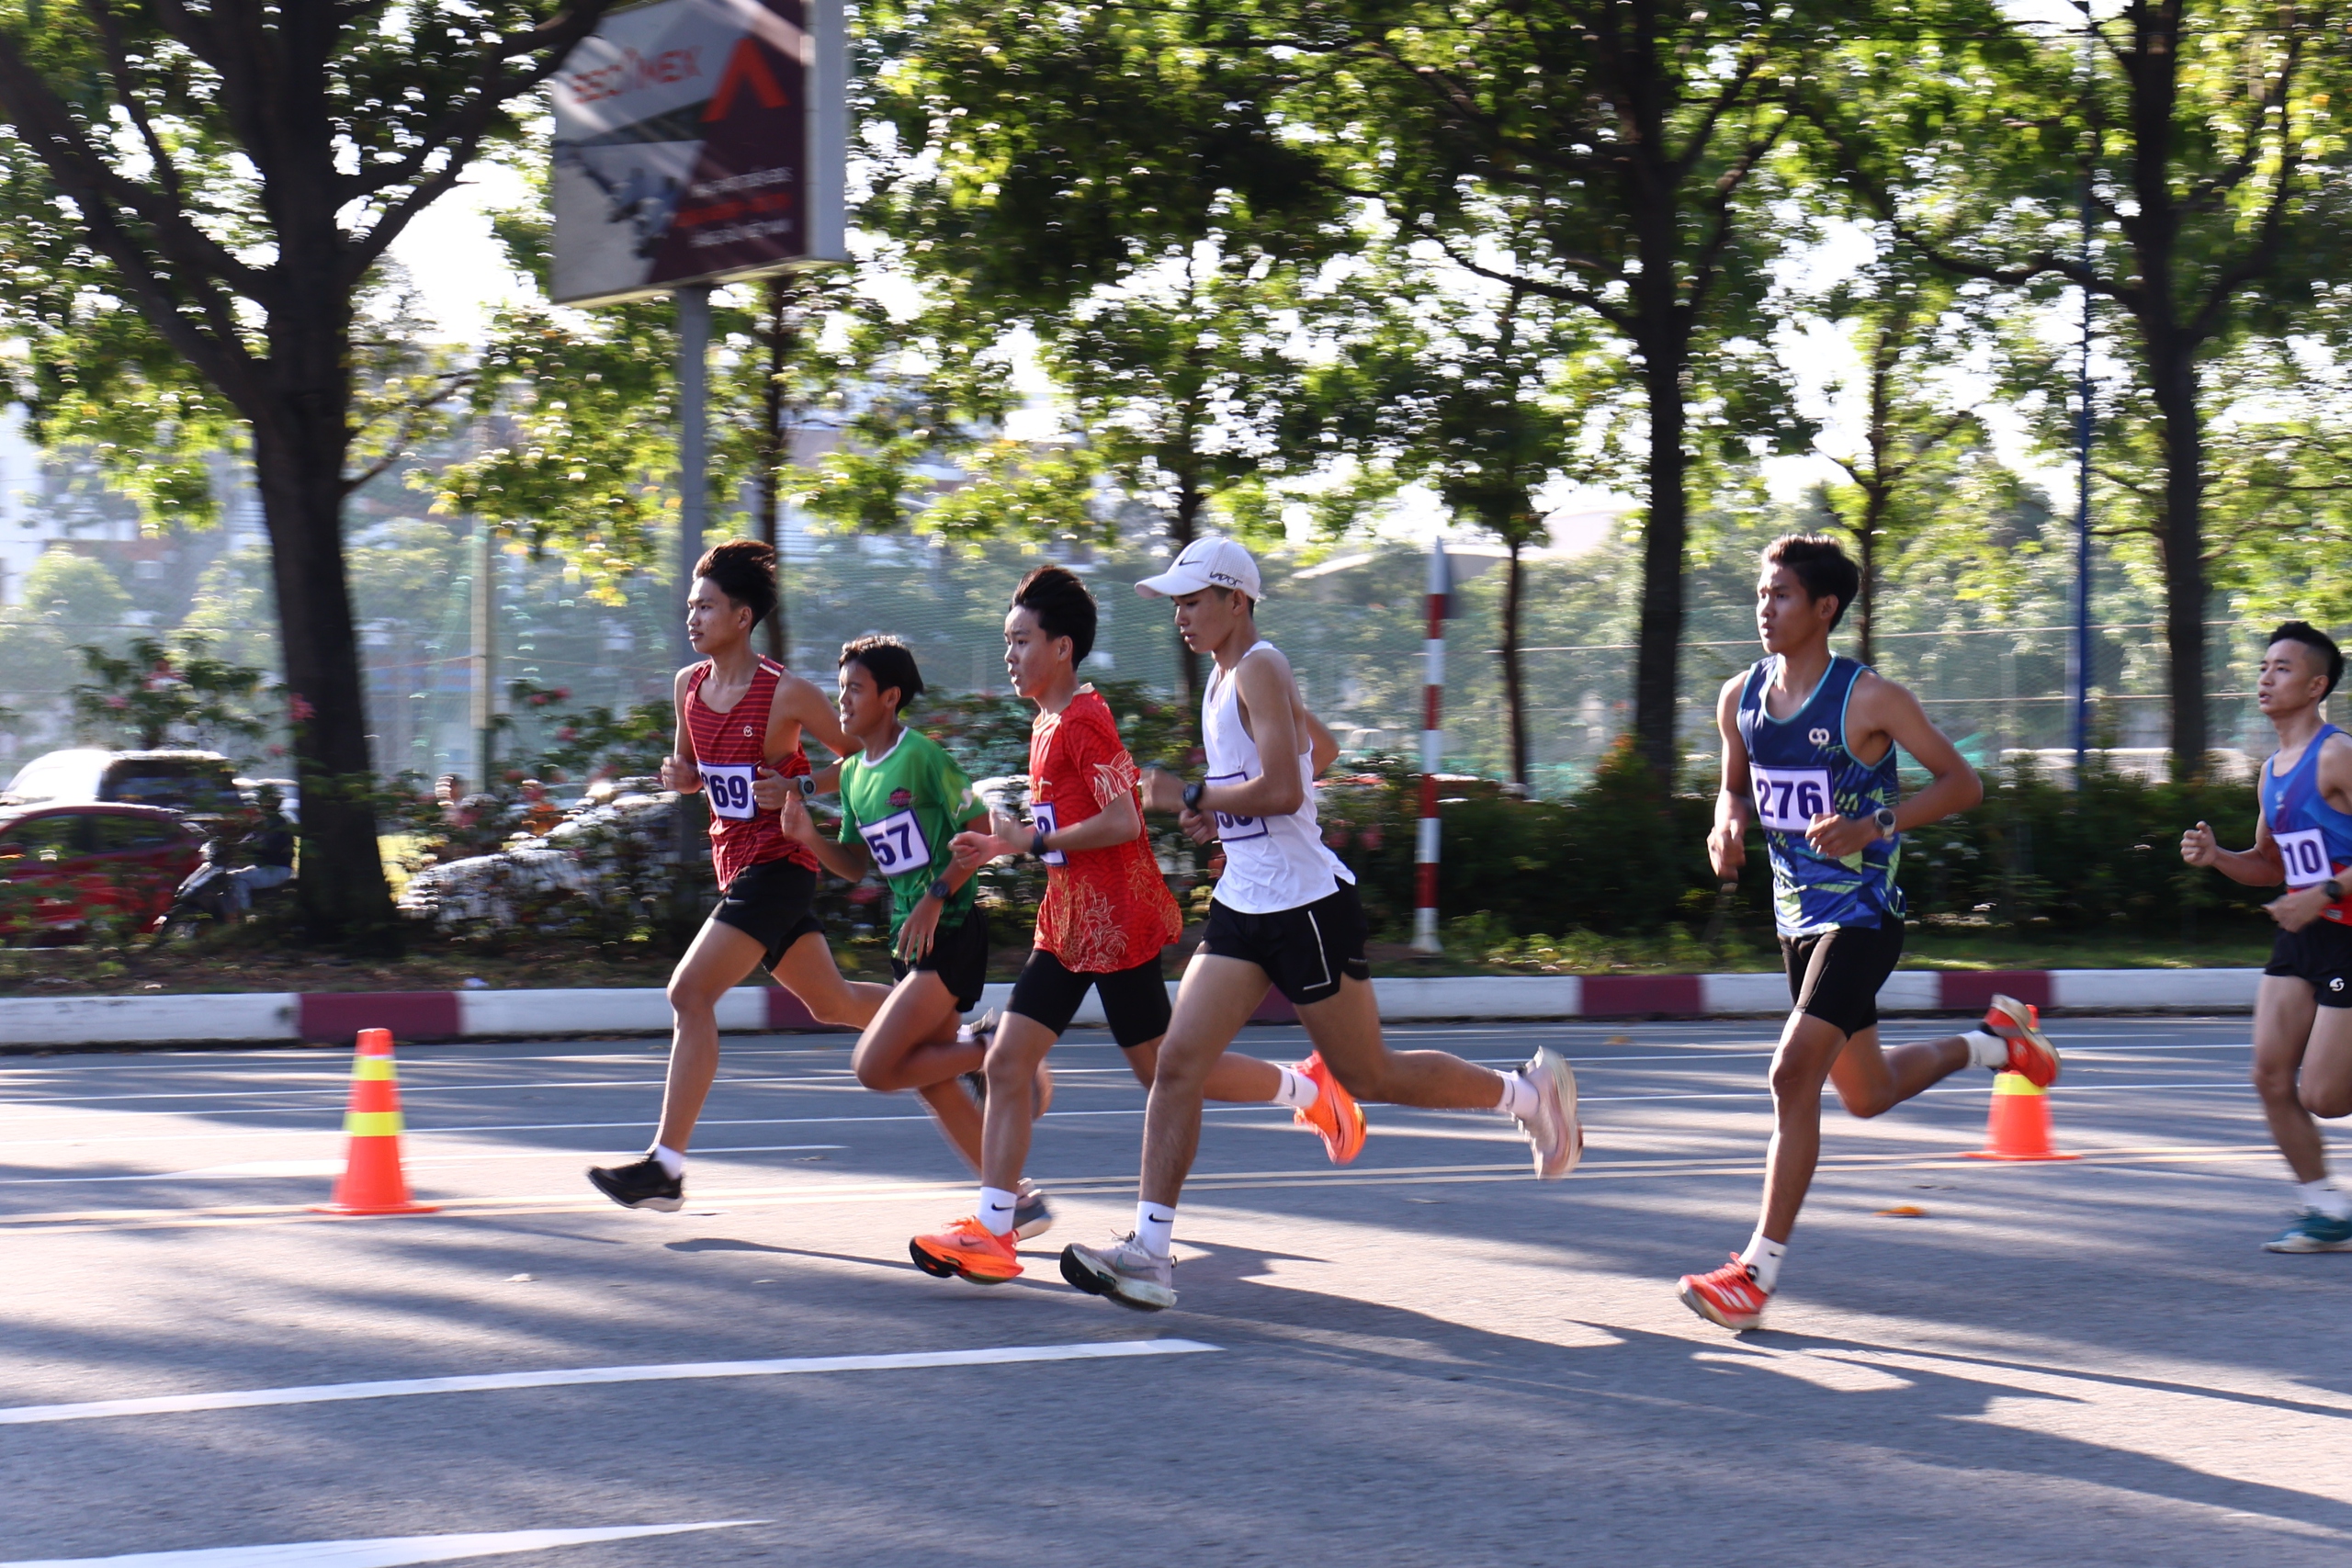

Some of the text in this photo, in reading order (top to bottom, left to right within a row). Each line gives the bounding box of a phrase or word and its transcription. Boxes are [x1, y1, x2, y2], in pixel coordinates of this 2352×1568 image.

[1756, 778, 1824, 820] 276
[866, 821, 912, 866] 57
[2283, 839, 2322, 876] 10
